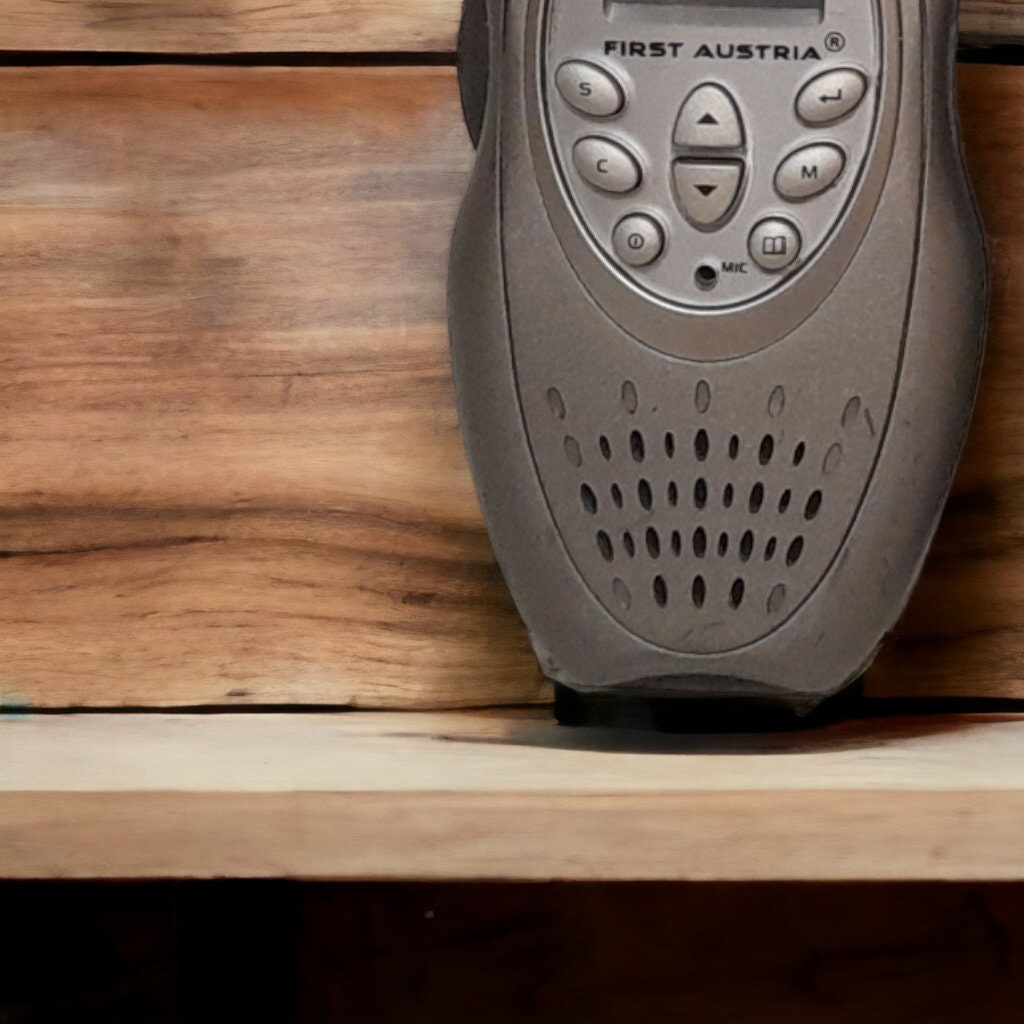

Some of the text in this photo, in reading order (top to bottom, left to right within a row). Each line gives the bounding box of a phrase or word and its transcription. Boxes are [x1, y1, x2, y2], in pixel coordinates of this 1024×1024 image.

[604, 40, 684, 59] FIRST
[693, 43, 822, 61] AUSTRIA
[579, 82, 593, 96] S
[596, 159, 608, 174] C
[802, 165, 818, 179] M
[721, 262, 748, 274] MIC
